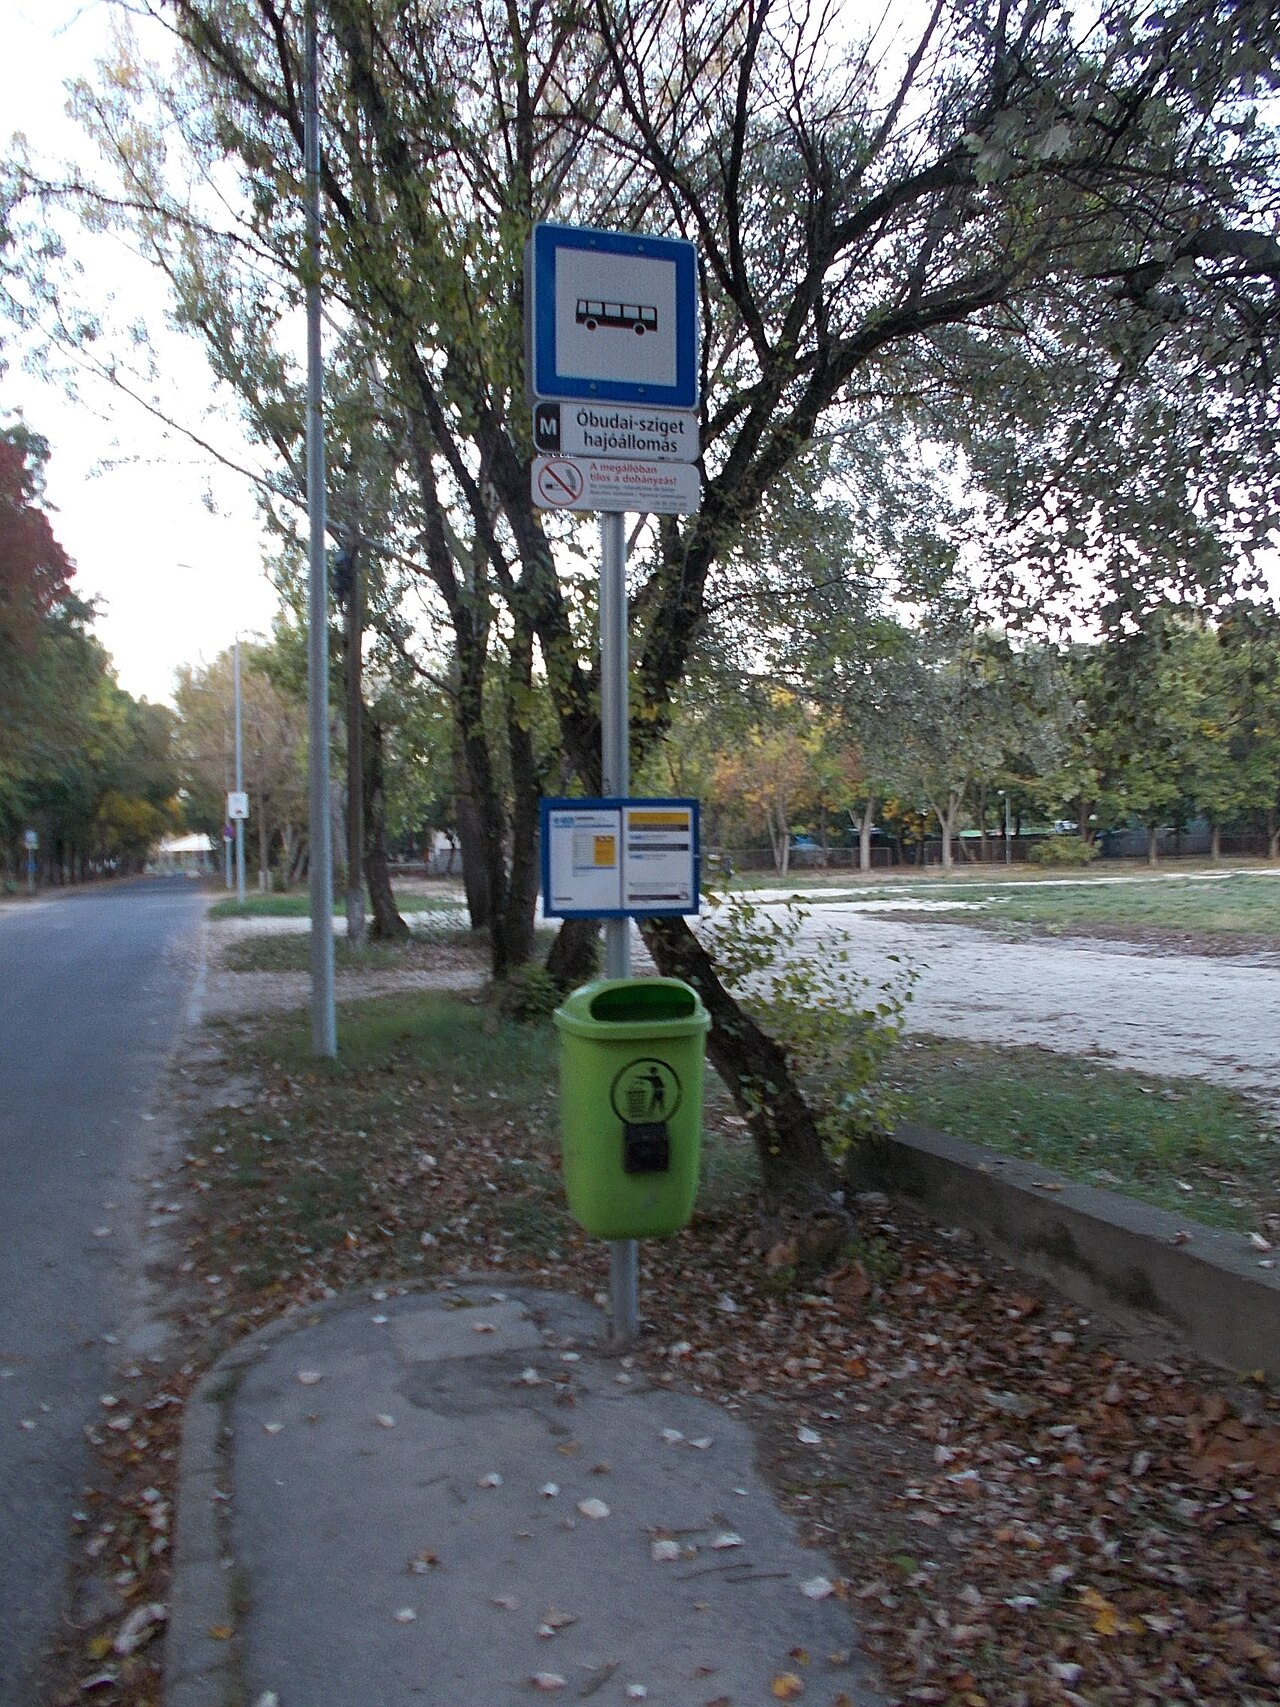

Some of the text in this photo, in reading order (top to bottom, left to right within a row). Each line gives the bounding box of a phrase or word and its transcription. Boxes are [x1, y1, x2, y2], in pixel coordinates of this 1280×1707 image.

[539, 417, 558, 436] M
[576, 407, 686, 437] Óbudai-sziget
[583, 430, 678, 453] hajóállomás
[590, 462, 657, 475] A megállóban
[590, 473, 610, 482] tilos
[623, 473, 677, 486] dohányzás!
